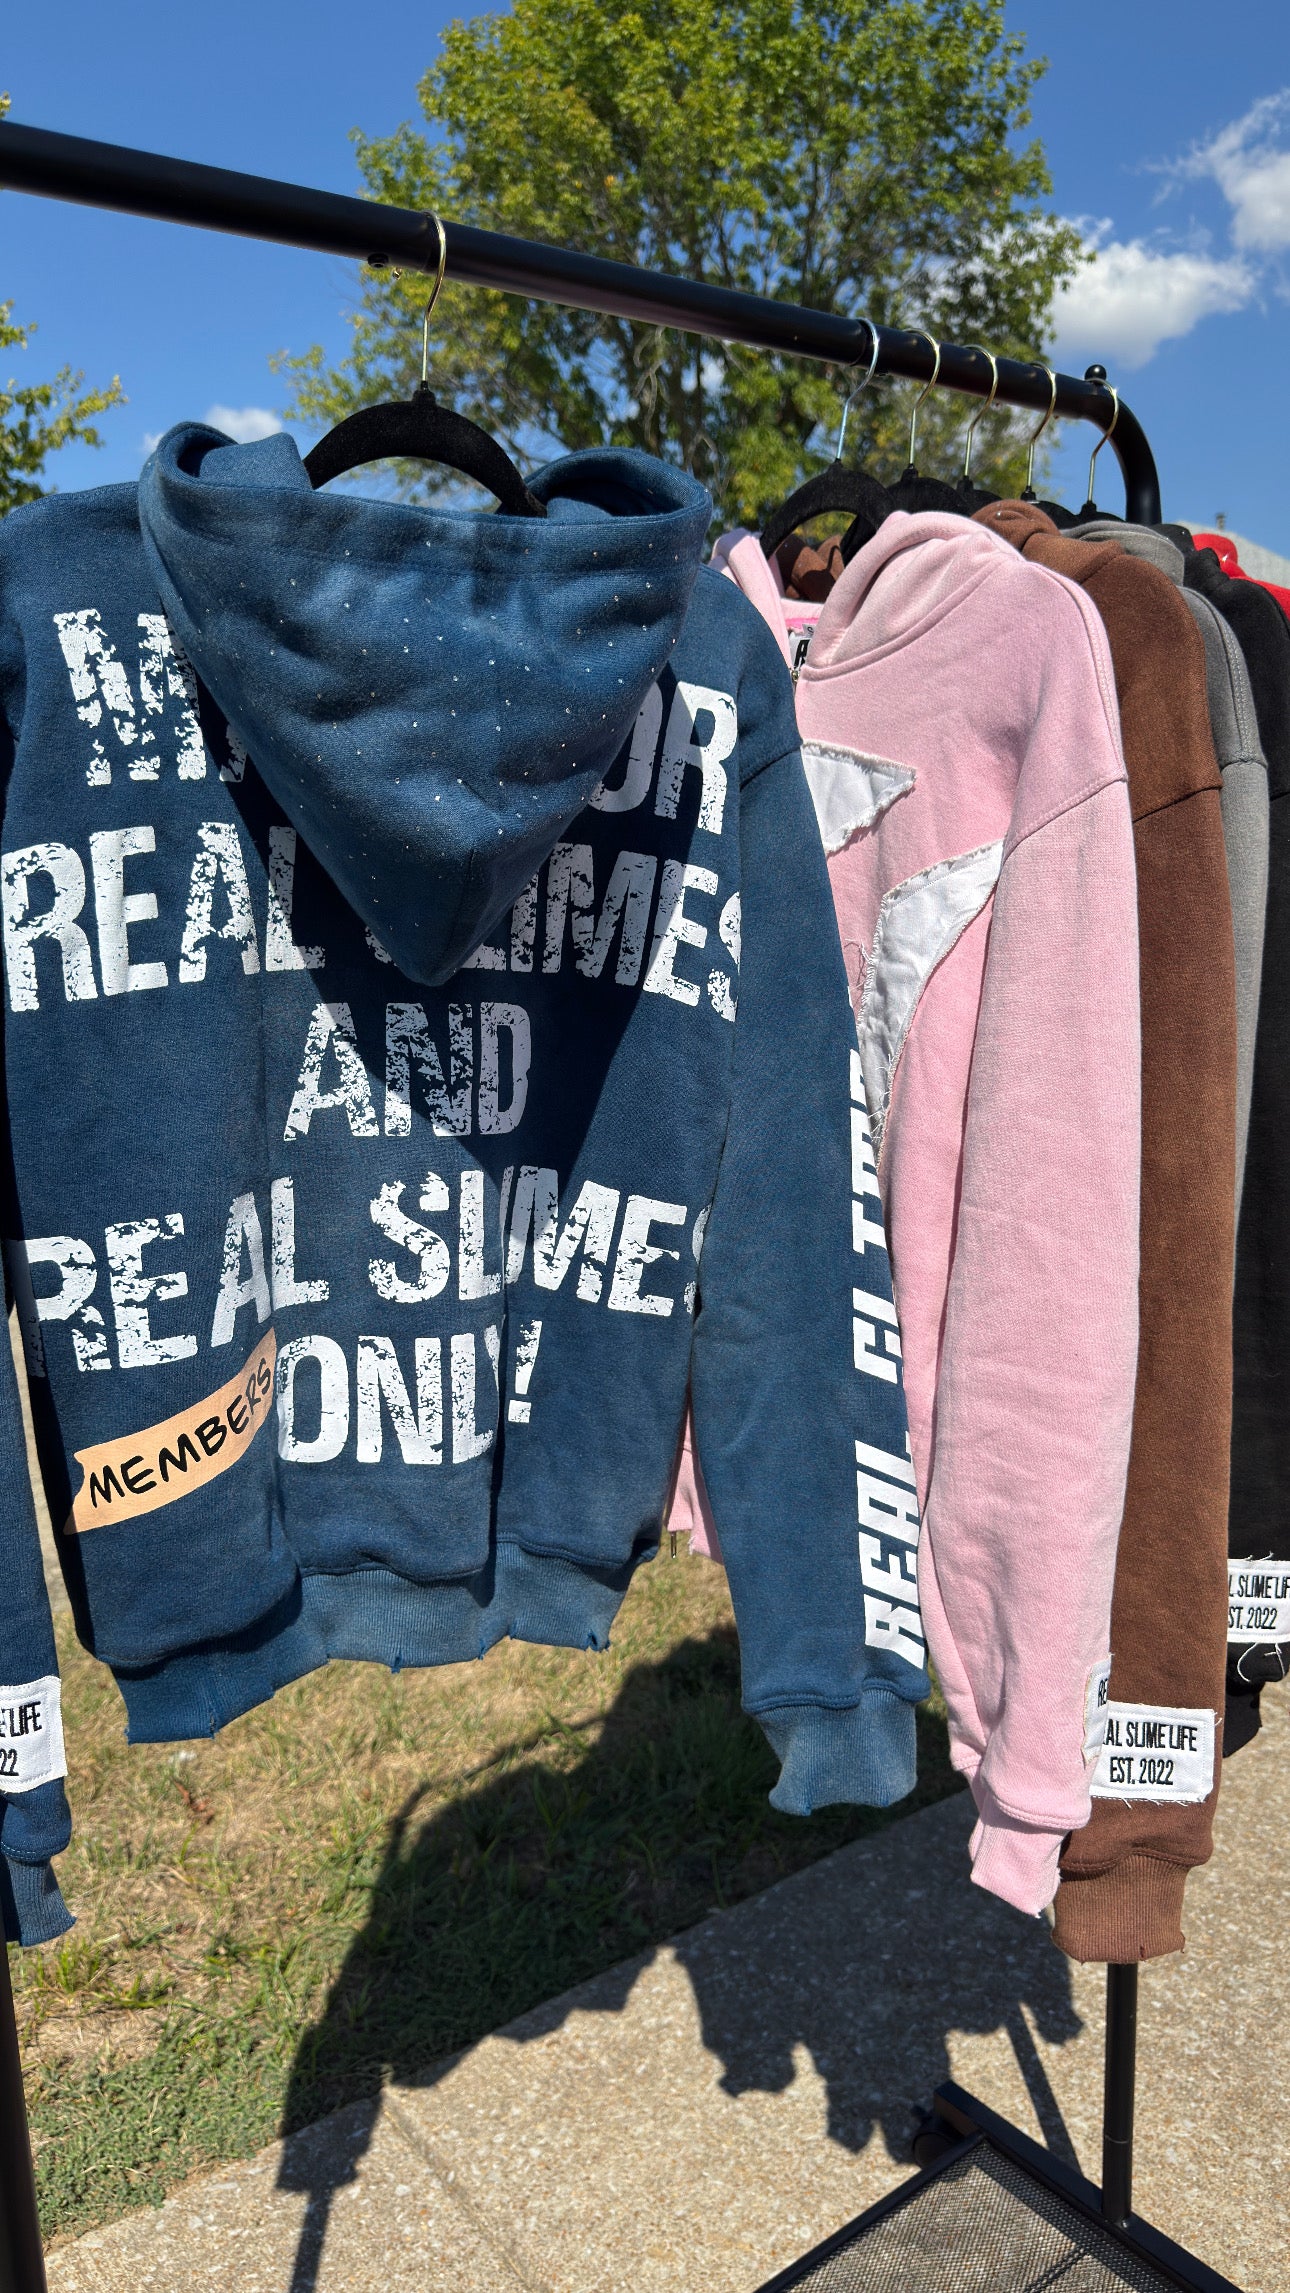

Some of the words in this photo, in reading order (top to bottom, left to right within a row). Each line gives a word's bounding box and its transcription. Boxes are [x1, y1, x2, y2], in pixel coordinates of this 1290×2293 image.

[588, 680, 738, 833] OR
[1, 822, 326, 1013] REAL
[284, 1002, 531, 1142] AND
[9, 1176, 329, 1379] REAL
[89, 1358, 272, 1509] MEMBERS
[1237, 1575, 1271, 1598] SLIME
[1275, 1575, 1290, 1599] LIF
[1228, 1606, 1243, 1630] ST.
[1246, 1606, 1278, 1630] 2022
[10, 1701, 42, 1737] LIFE
[1103, 1718, 1122, 1746] AL
[1126, 1721, 1165, 1749] SLIME
[1169, 1724, 1197, 1752] LIFE
[0, 1748, 19, 1776] 22
[1110, 1756, 1135, 1785] EST.
[1139, 1758, 1174, 1786] 2022
